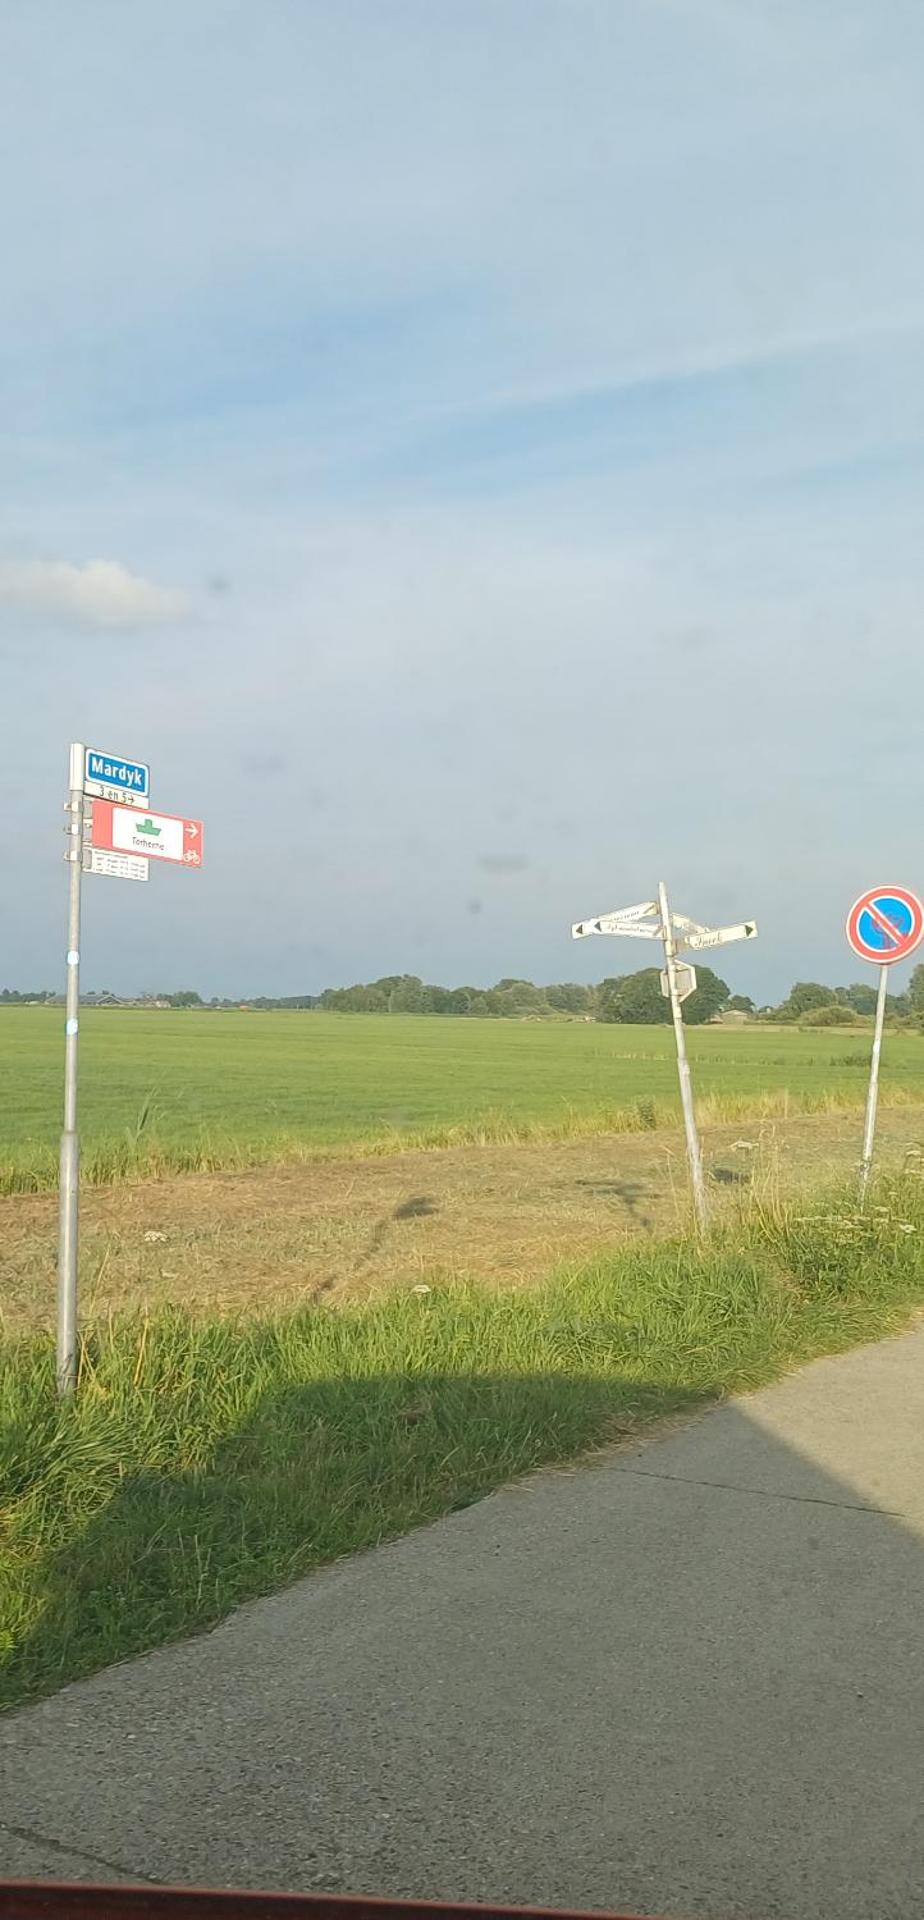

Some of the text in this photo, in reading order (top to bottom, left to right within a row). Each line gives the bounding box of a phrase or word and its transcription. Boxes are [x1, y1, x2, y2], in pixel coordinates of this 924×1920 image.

[91, 757, 142, 787] Mardyk
[100, 785, 127, 803] 3 en 5
